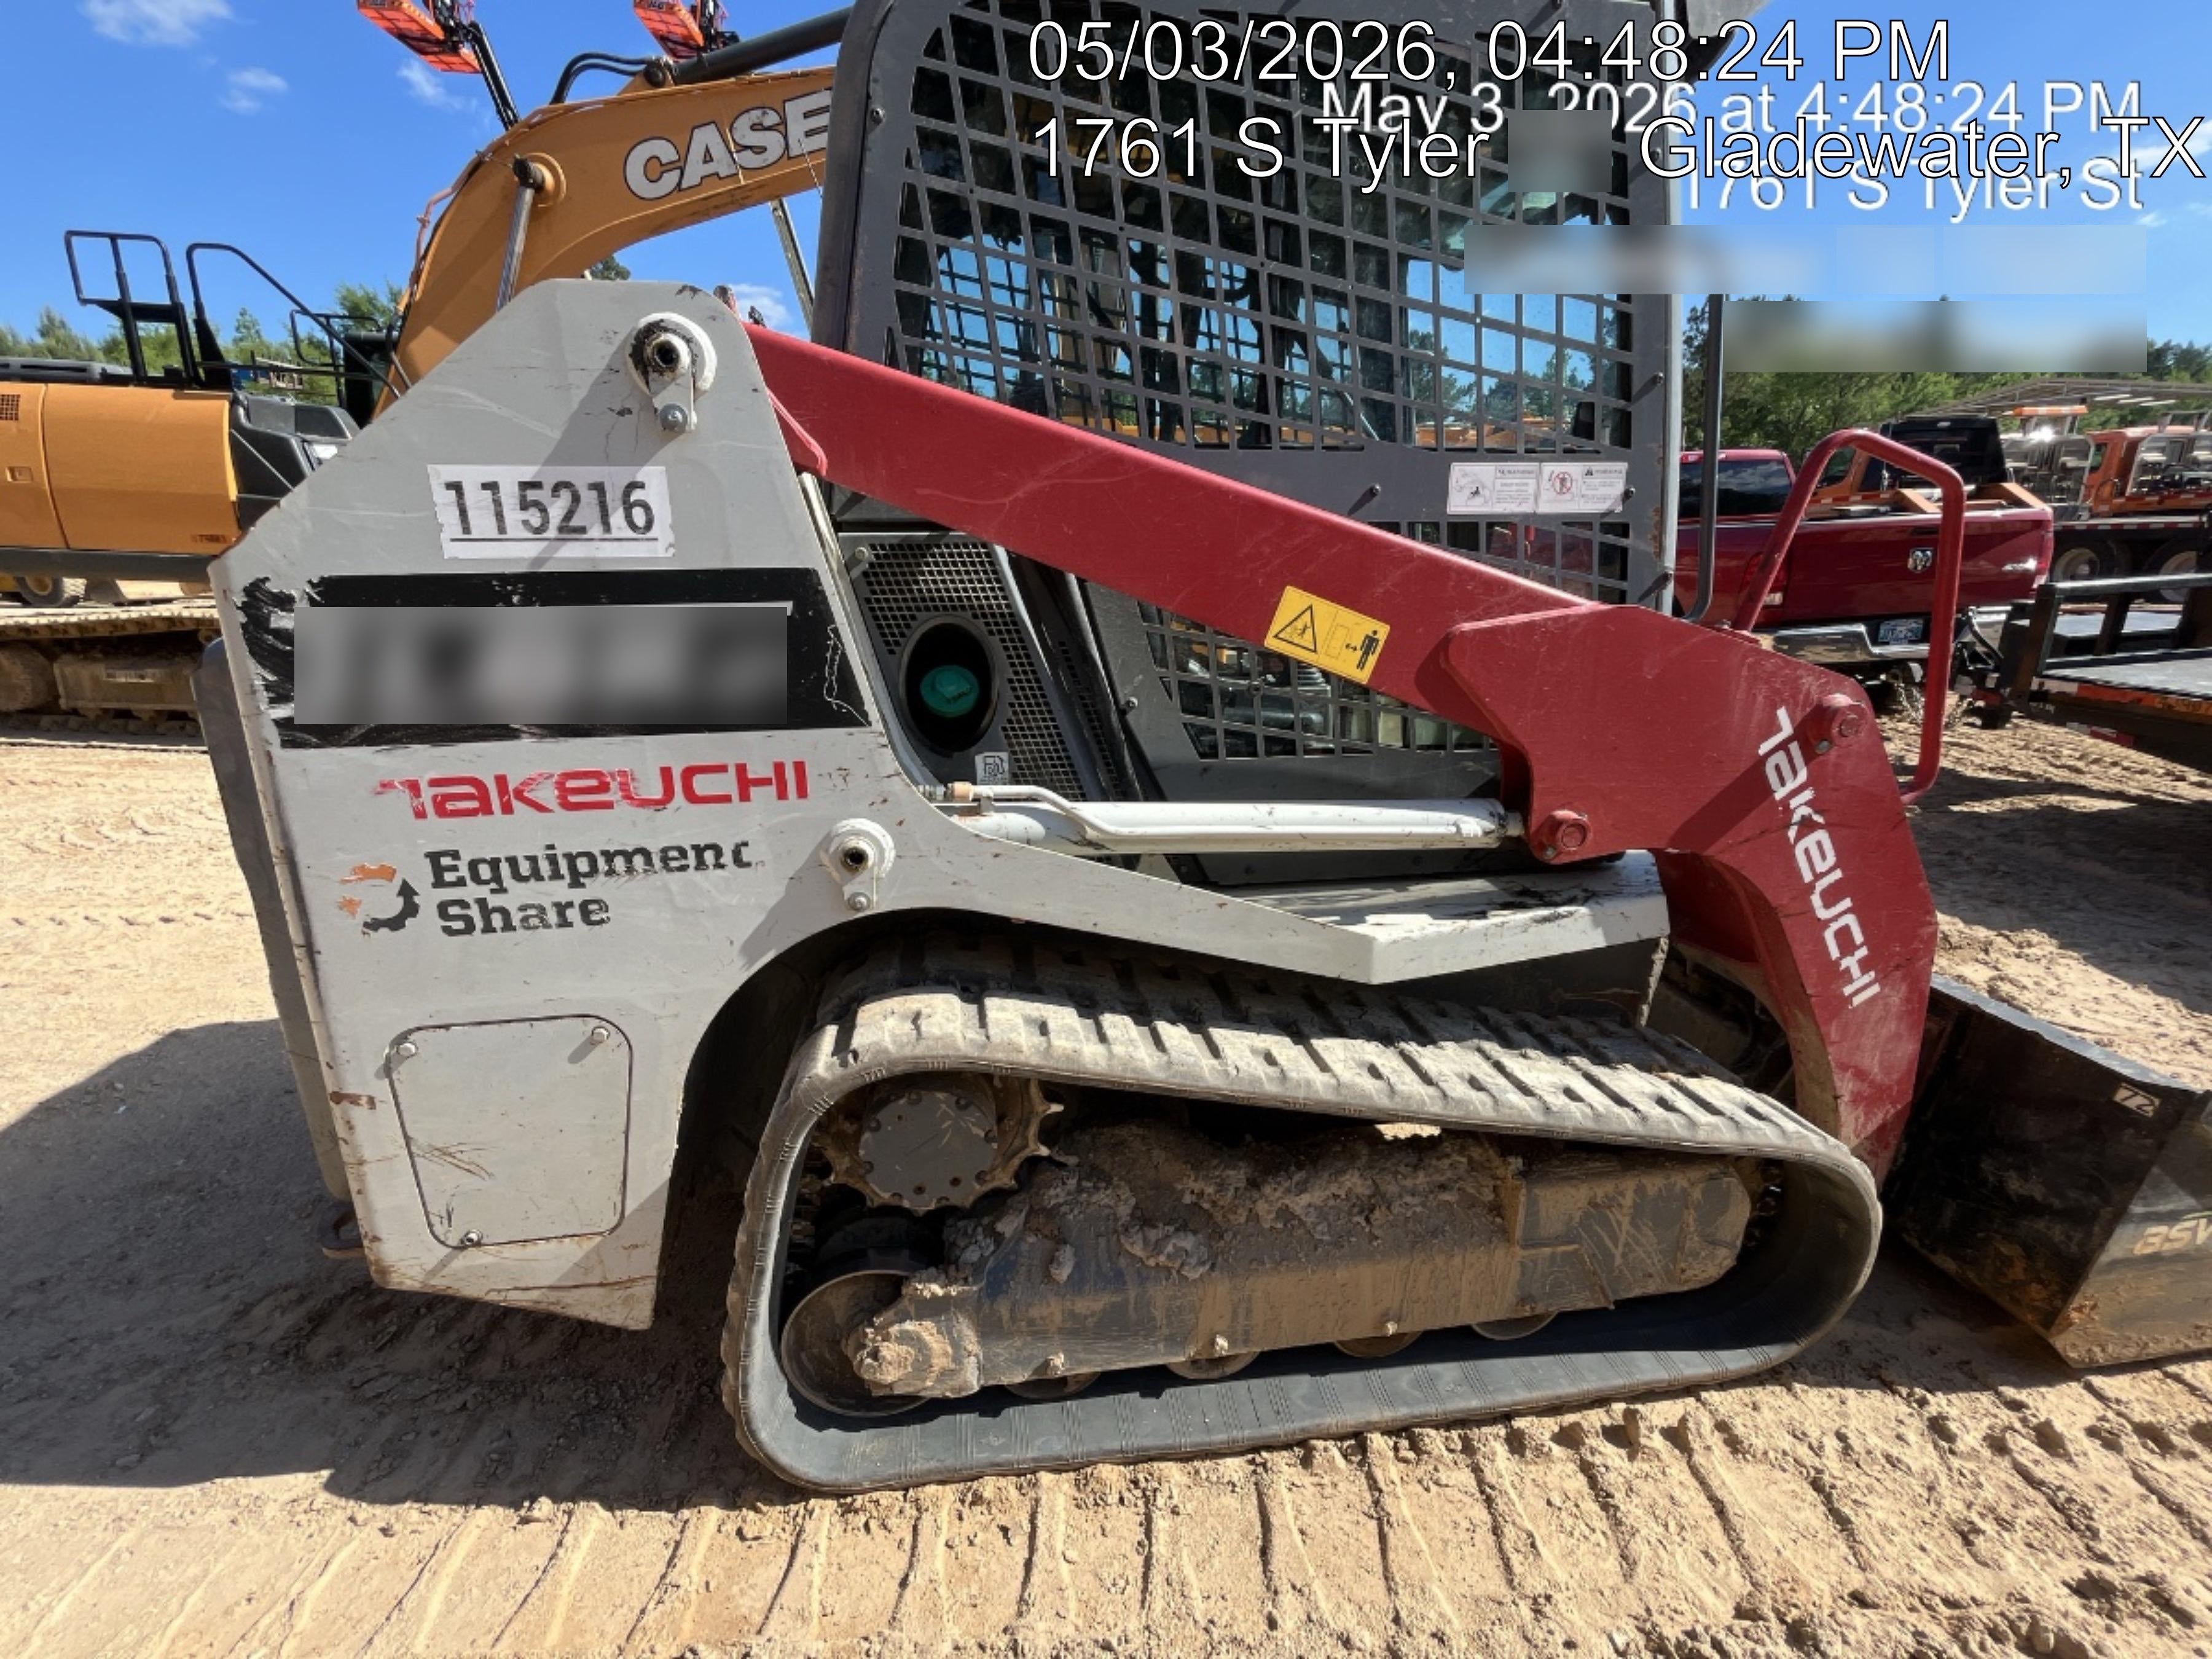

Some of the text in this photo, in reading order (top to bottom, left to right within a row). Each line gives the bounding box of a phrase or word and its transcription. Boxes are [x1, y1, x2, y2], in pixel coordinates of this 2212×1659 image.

[623, 87, 833, 200] CASE
[444, 480, 654, 535] 115216
[436, 896, 611, 937] Share
